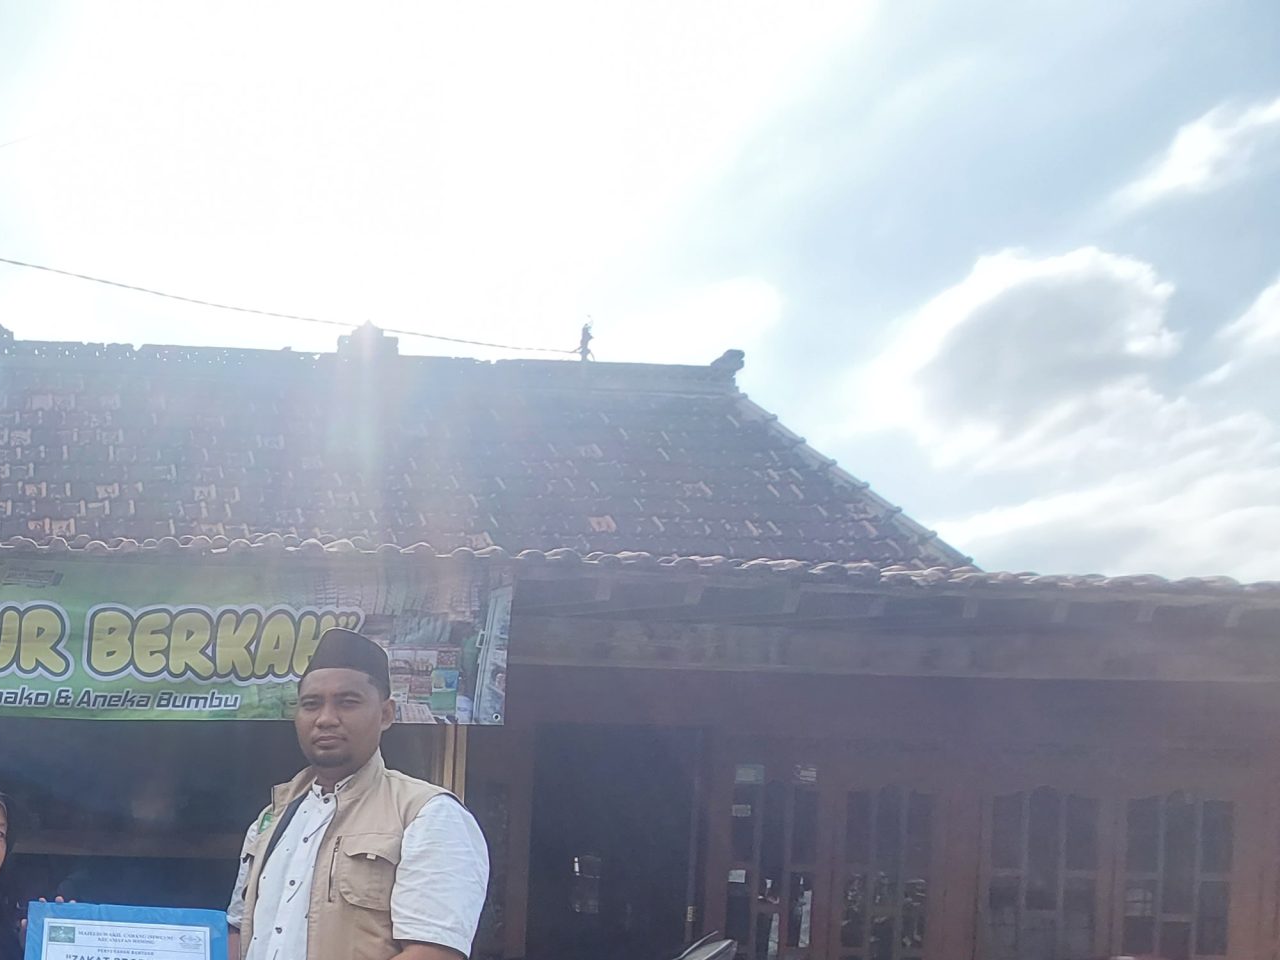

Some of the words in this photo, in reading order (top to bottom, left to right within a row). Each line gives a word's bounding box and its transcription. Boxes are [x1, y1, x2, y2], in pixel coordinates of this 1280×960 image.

[55, 688, 71, 707] &
[76, 689, 152, 709] Aneka
[156, 689, 241, 711] Bumbu
